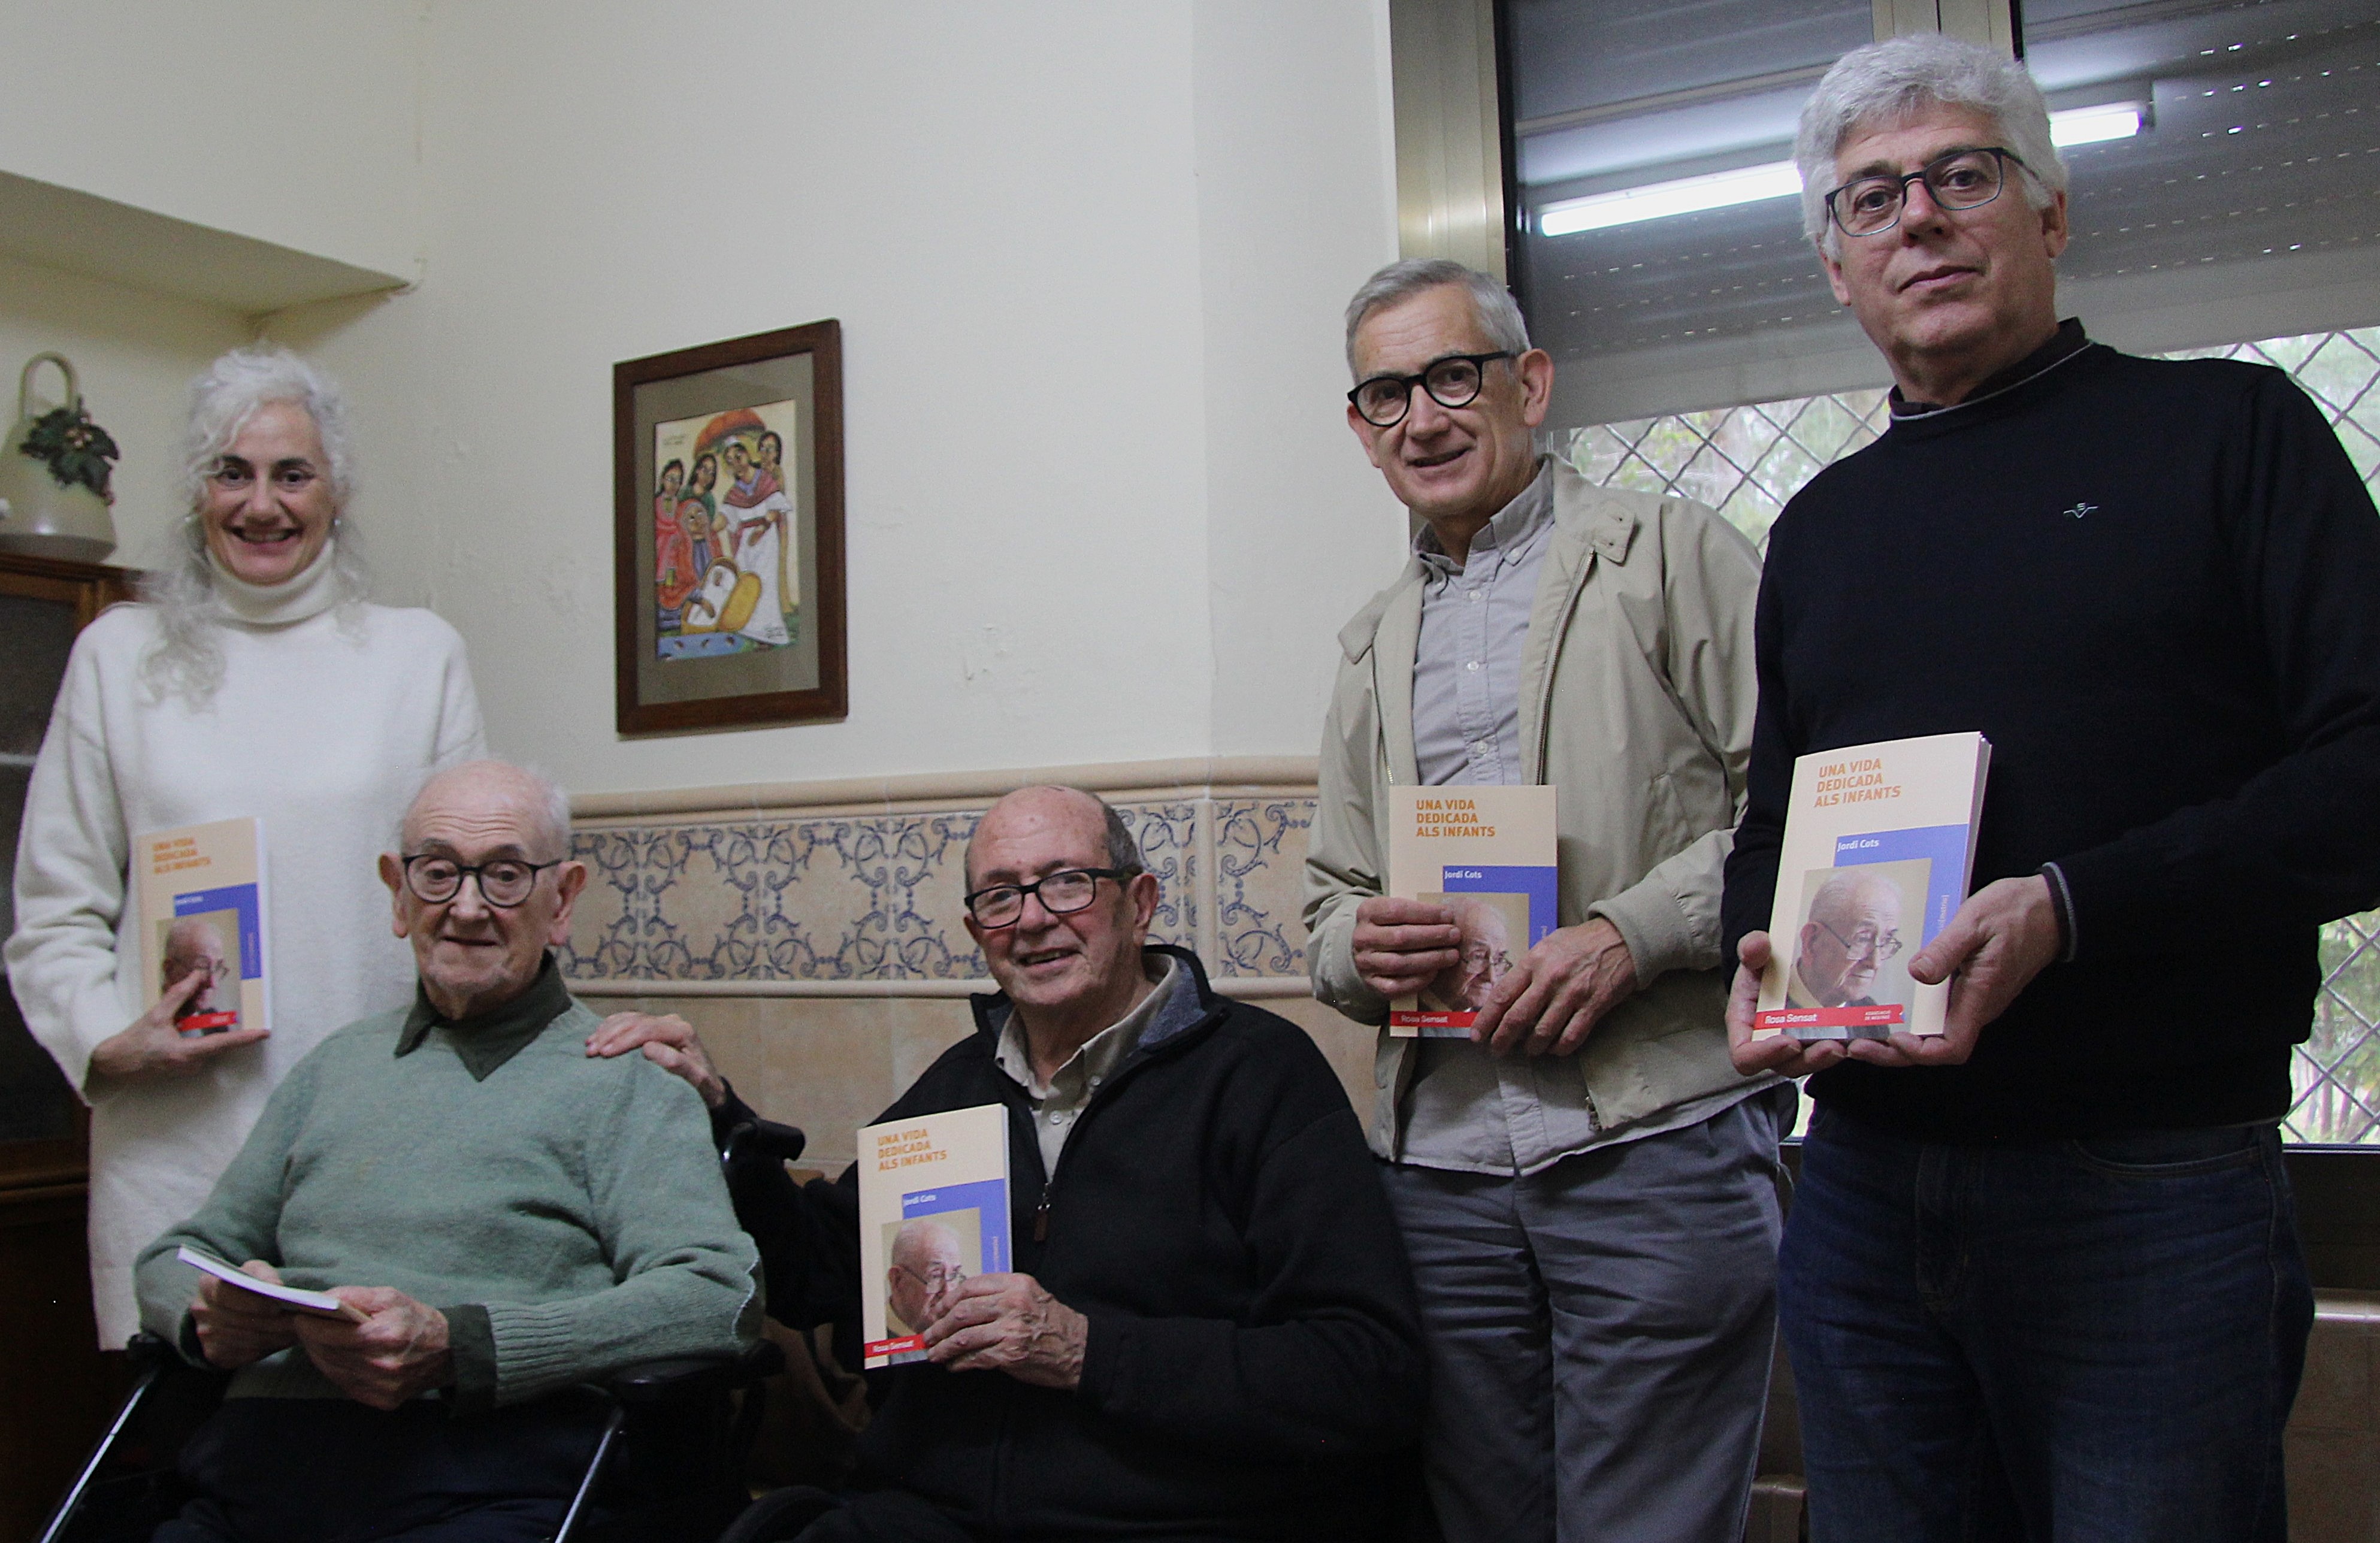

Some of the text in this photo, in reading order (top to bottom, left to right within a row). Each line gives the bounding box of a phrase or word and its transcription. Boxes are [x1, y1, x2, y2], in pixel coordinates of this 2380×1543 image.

[1819, 758, 1882, 777] UNA VIDA
[1817, 773, 1883, 792] DEDICADA
[1814, 785, 1901, 807] ALS INFANTS
[1416, 799, 1475, 810] UNA VIDA
[1417, 813, 1478, 823] DEDICADA
[1416, 826, 1496, 837] ALS INFANTS
[1837, 839, 1879, 852] Jordi Cots
[1444, 870, 1483, 879] Jordi Cots
[1765, 1013, 1817, 1024] Rosa Sensat
[878, 1128, 927, 1146] UNA VIDA
[878, 1140, 931, 1159] DEDICADA
[879, 1150, 947, 1172] ALS INFANTS
